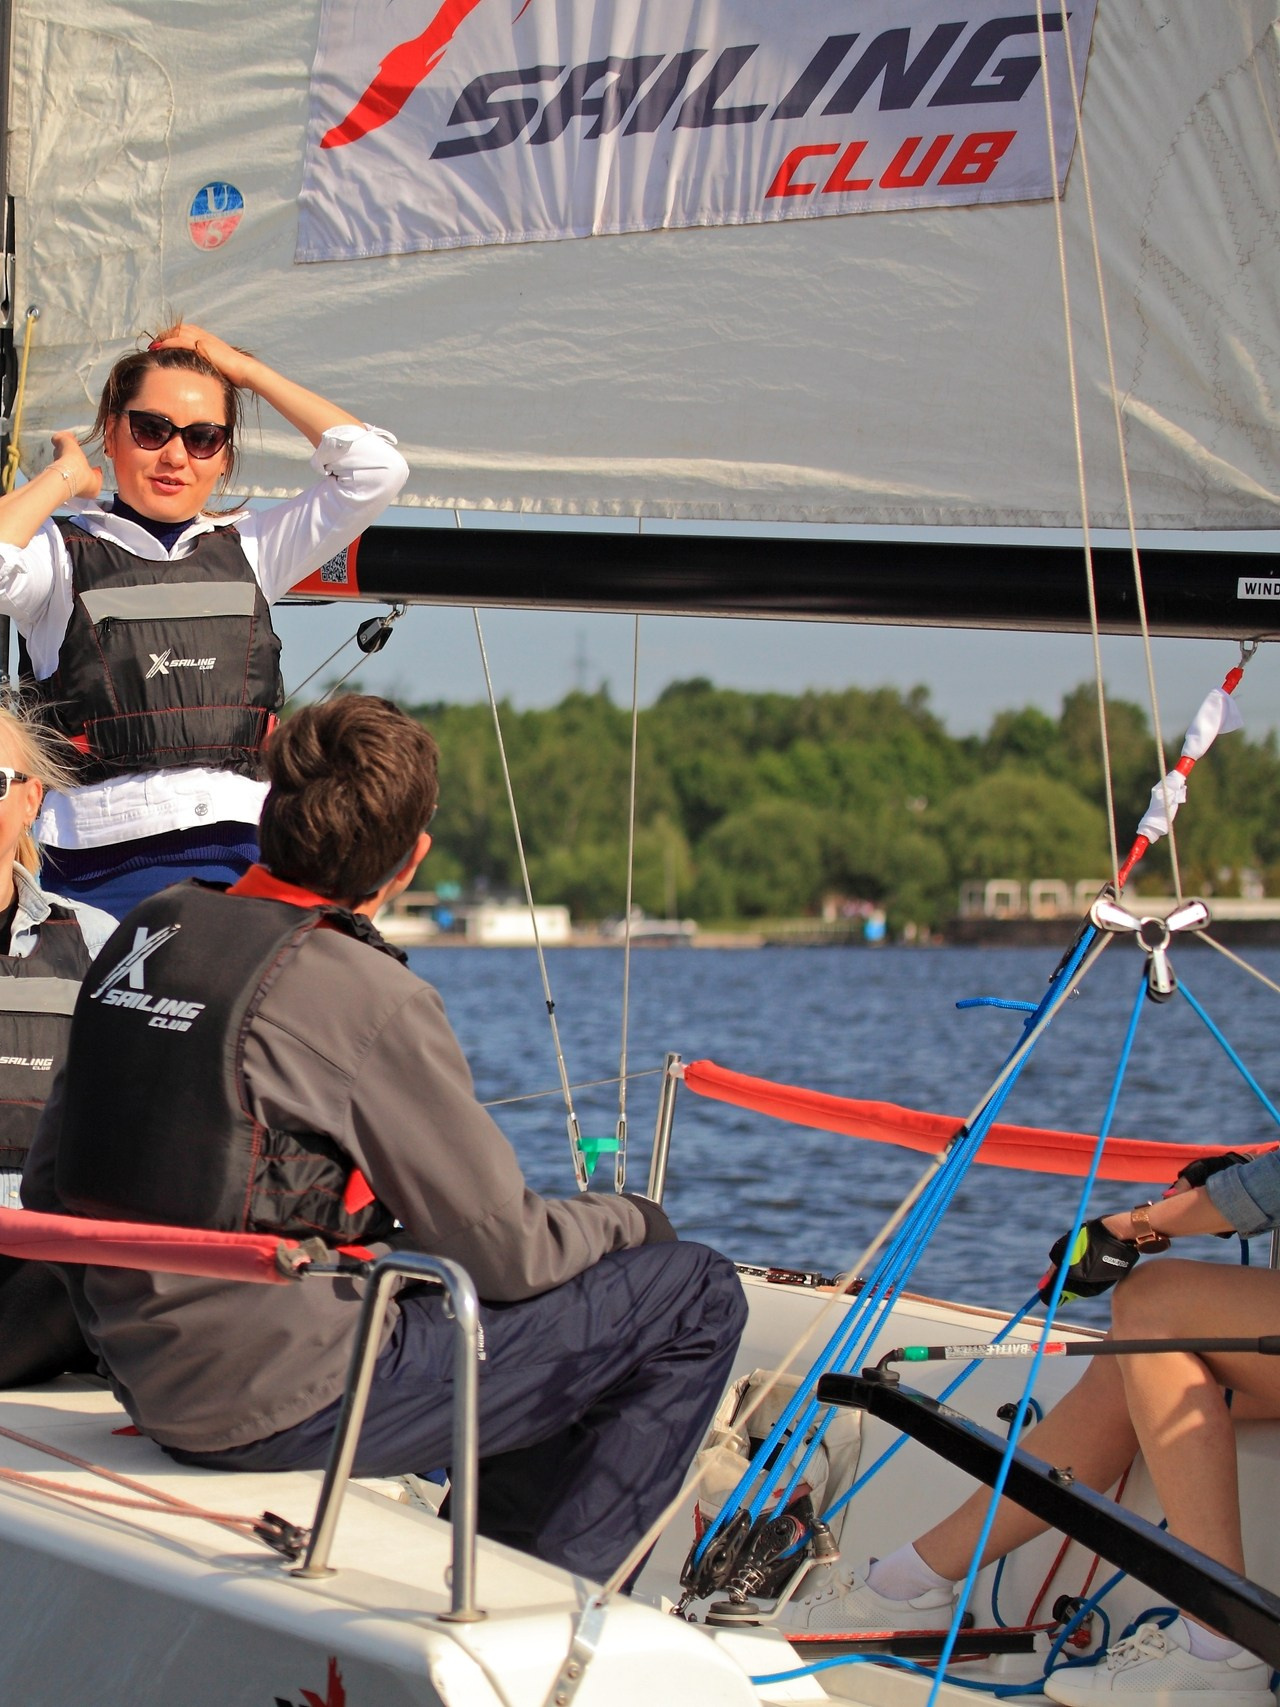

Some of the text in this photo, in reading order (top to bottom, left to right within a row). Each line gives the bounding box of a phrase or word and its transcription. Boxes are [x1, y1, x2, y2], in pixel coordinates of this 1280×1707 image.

[429, 12, 1071, 160] SAILING
[765, 130, 1017, 198] CLUB
[1245, 582, 1280, 595] WIND
[101, 988, 206, 1019] SAILING
[148, 1016, 193, 1032] CLUB
